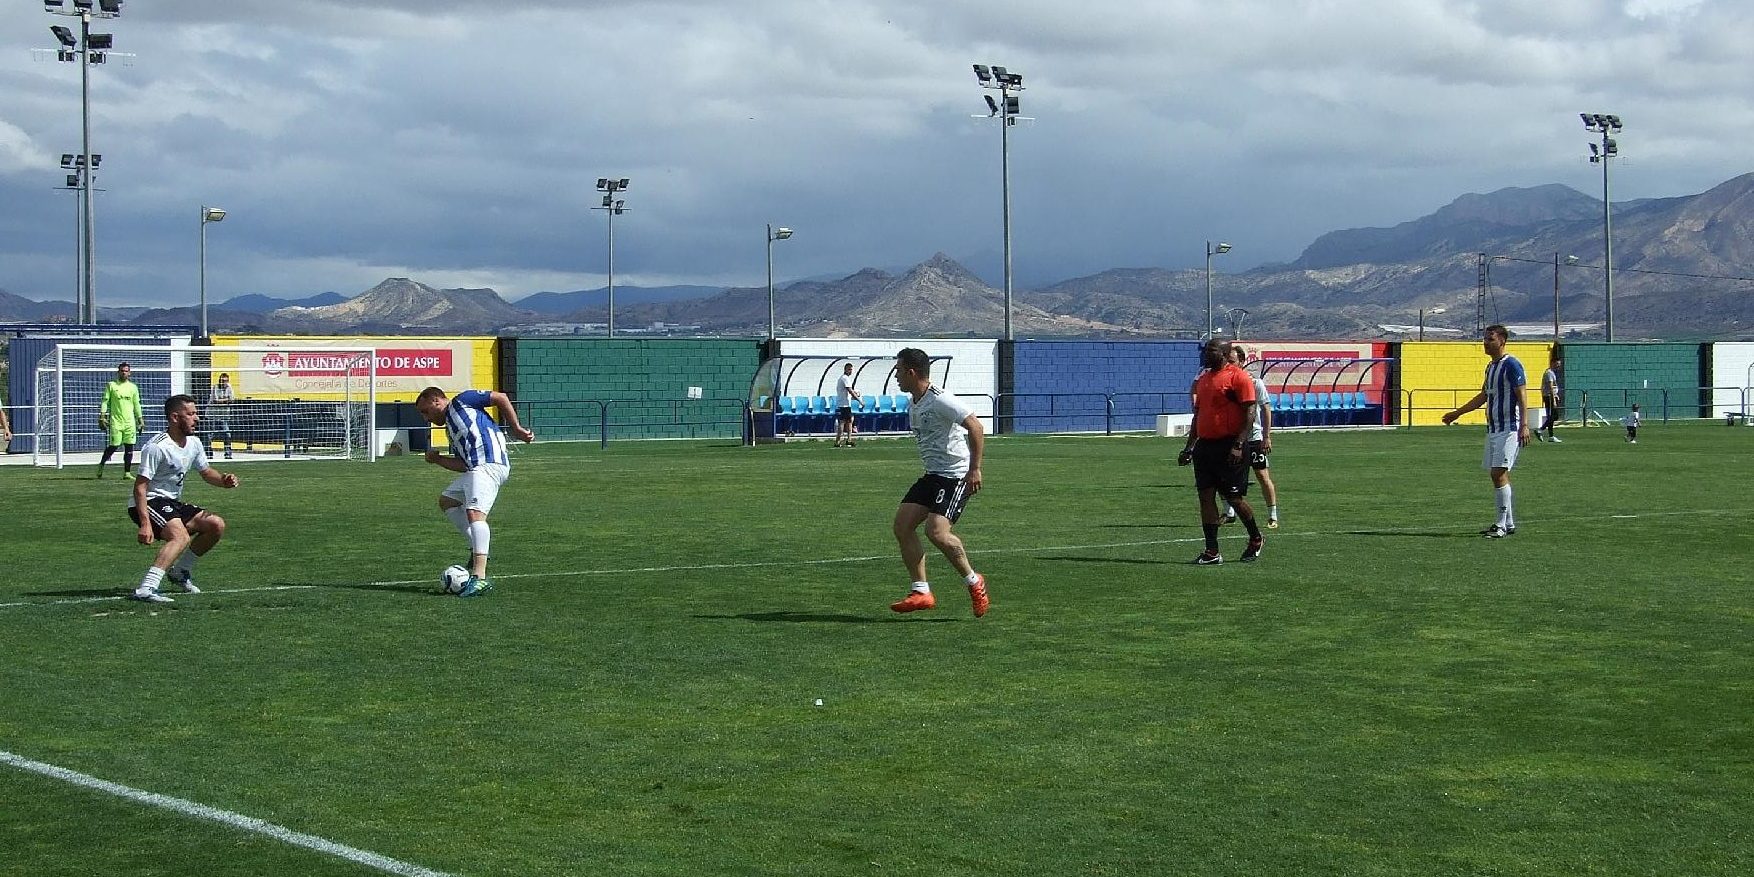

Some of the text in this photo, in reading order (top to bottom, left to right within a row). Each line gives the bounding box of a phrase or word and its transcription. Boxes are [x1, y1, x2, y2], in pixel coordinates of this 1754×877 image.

[294, 357, 440, 369] AYUNTAMIENTO DE ASPE
[358, 379, 397, 388] Deortes
[935, 488, 946, 504] 8
